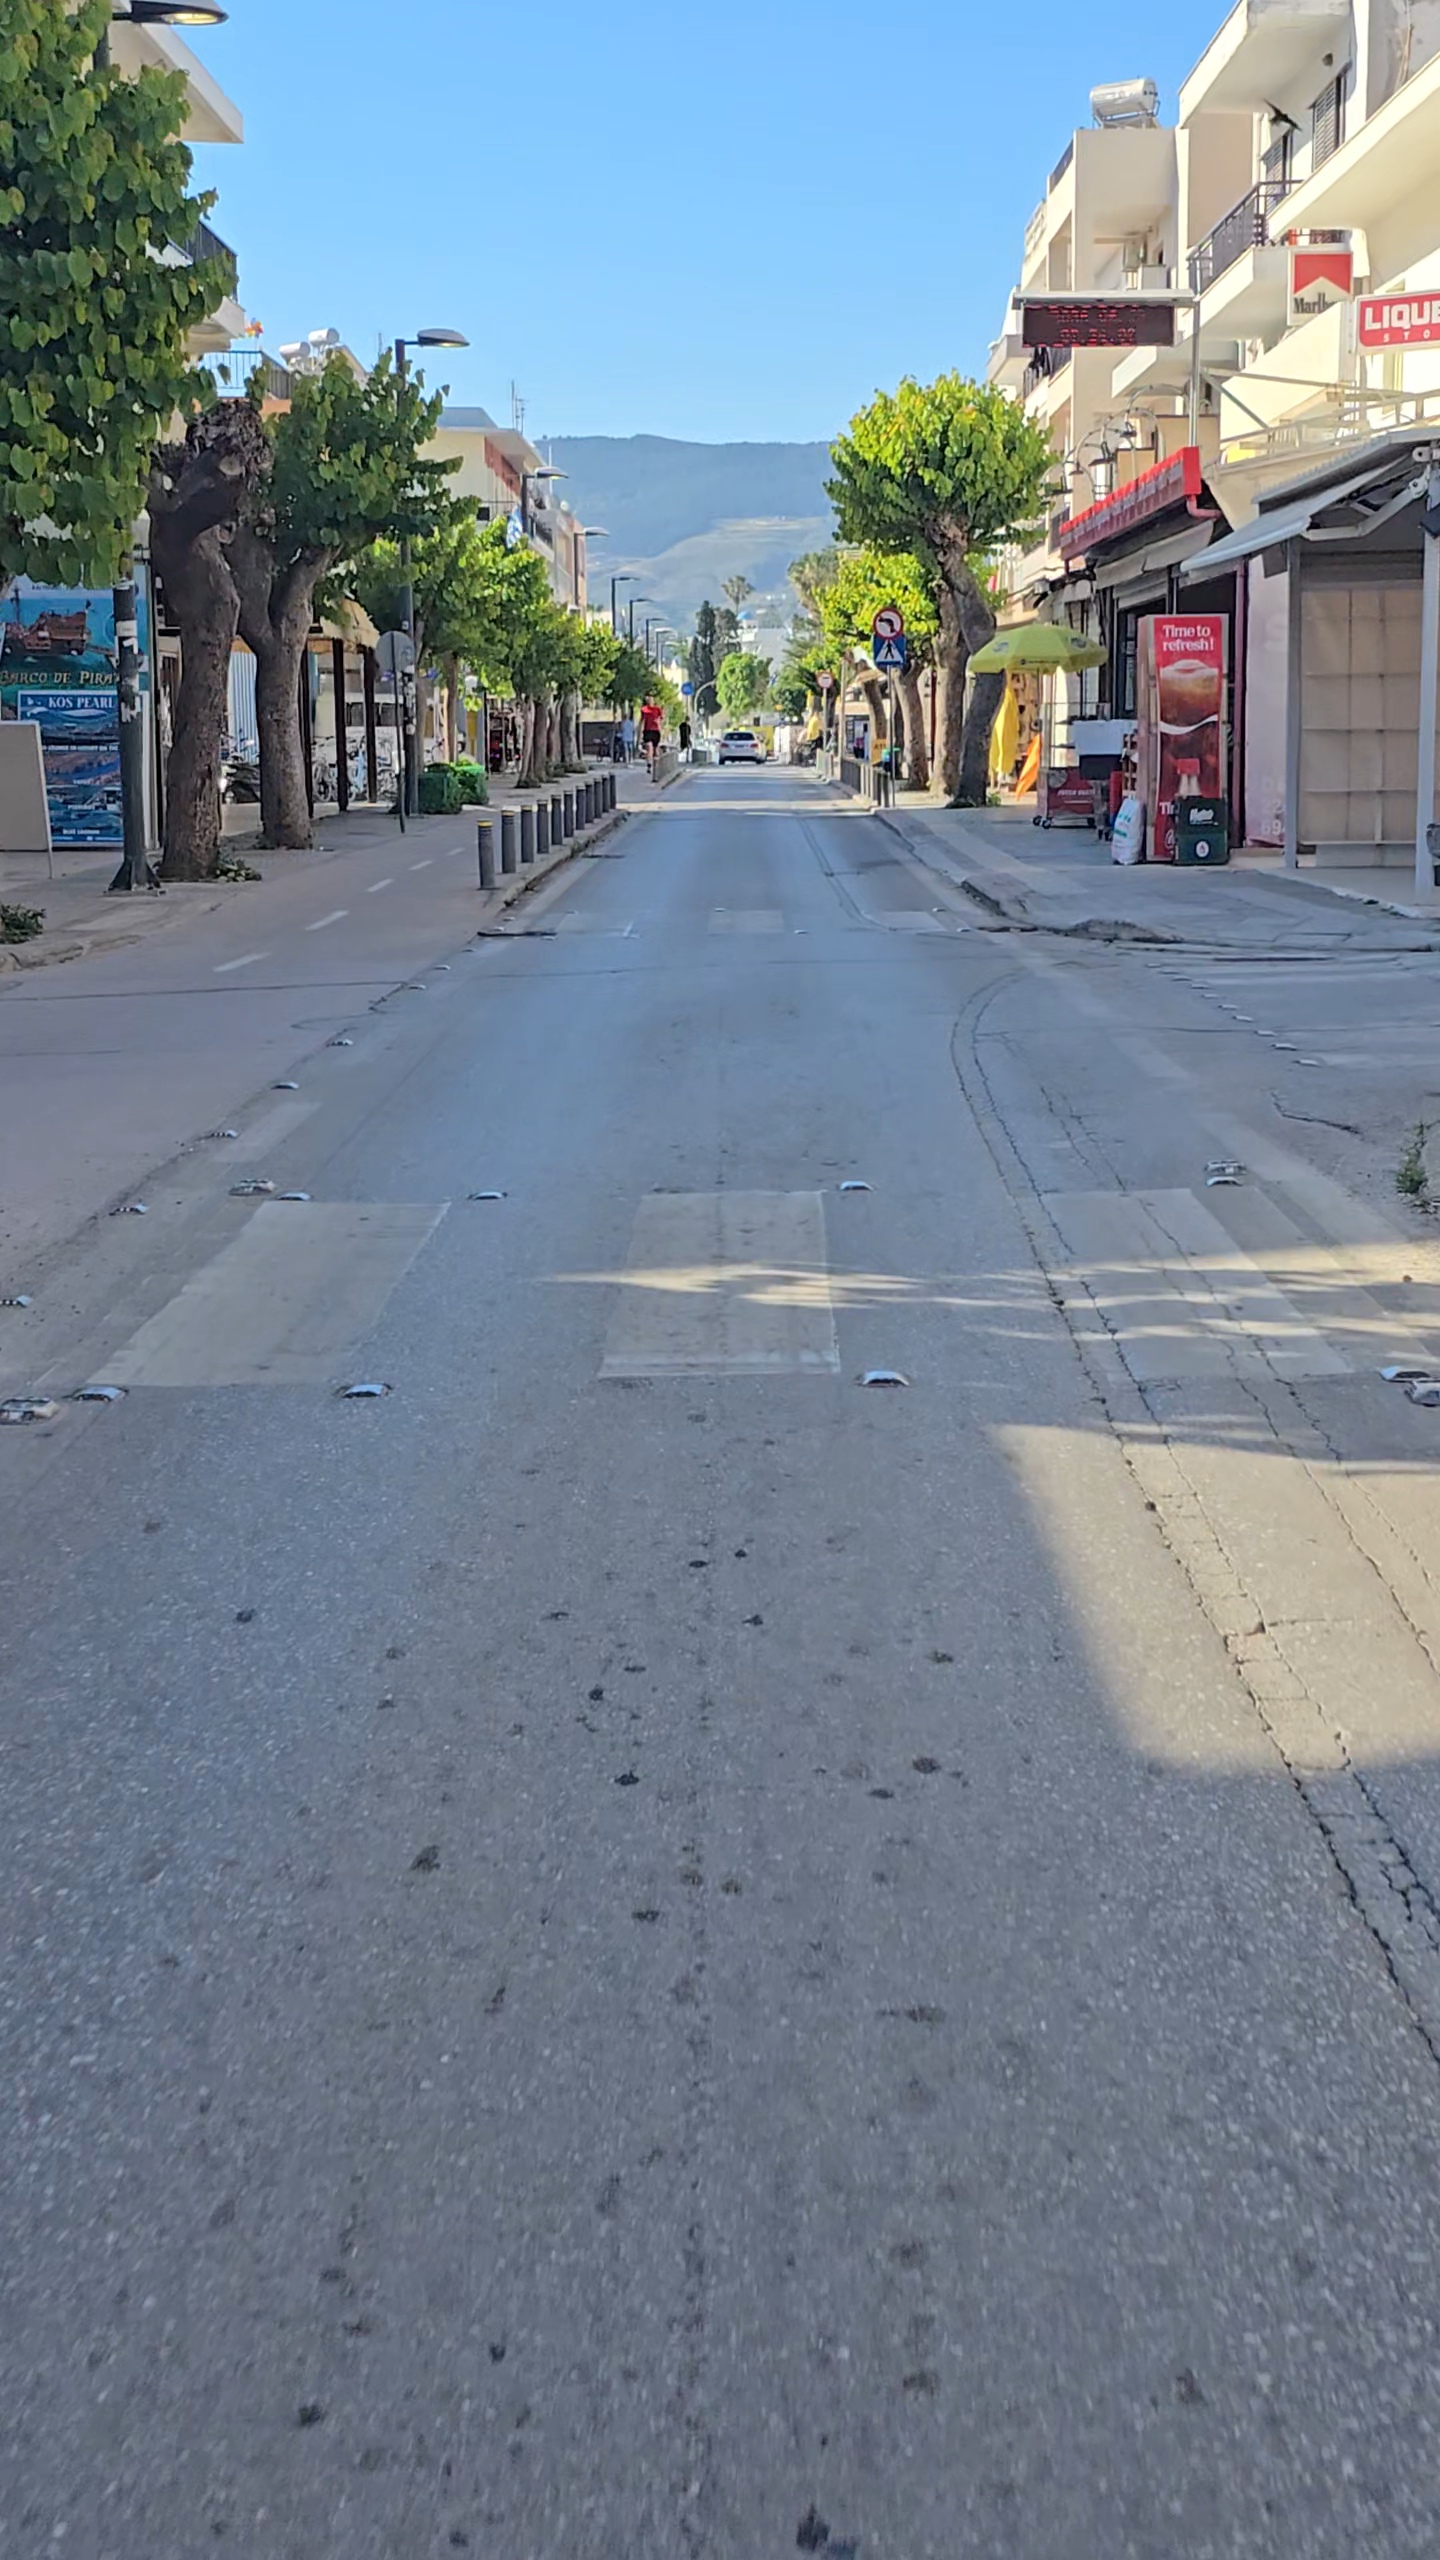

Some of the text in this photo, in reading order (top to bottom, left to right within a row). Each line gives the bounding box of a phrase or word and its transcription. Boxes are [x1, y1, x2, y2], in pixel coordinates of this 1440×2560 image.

[1365, 300, 1440, 331] LIQUE
[1162, 624, 1211, 638] Time to
[53, 672, 72, 684] DE
[48, 696, 113, 709] KOS PEARL
